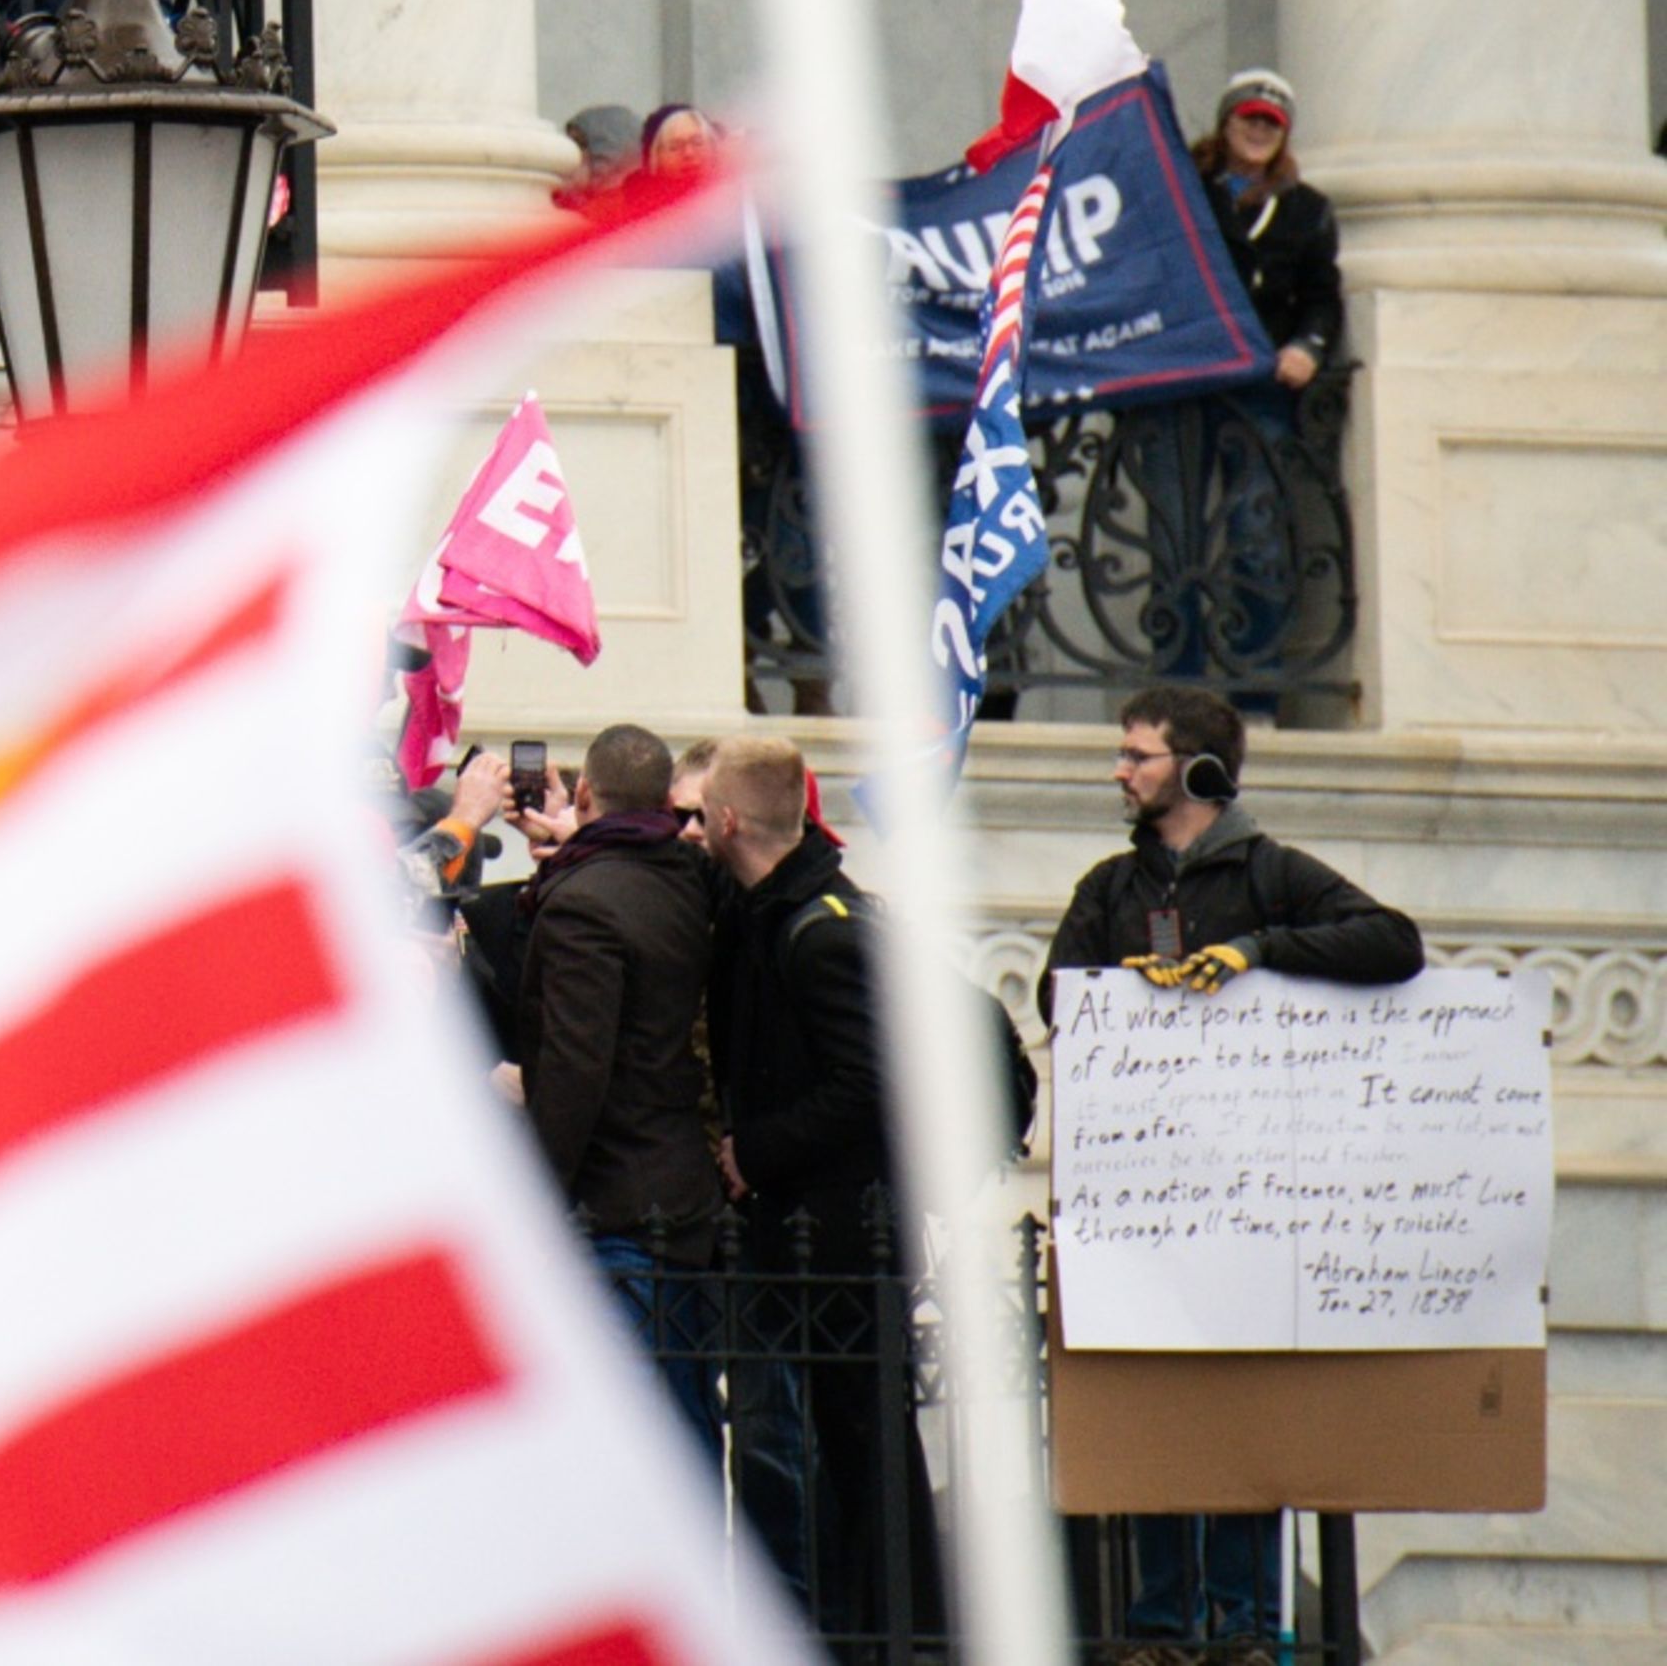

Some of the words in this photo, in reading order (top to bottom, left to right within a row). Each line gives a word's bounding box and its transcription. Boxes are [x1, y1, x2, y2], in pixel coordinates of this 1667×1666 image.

[1069, 988, 1115, 1037] At
[1126, 990, 1193, 1032] what
[1200, 995, 1263, 1046] point
[1275, 998, 1331, 1029] then
[1369, 995, 1410, 1025] the
[1418, 993, 1516, 1039] approach
[1069, 1044, 1107, 1084] of
[1111, 1043, 1202, 1090] danger
[1214, 1041, 1243, 1071] to
[1251, 1043, 1273, 1069] be
[1357, 1071, 1399, 1110] It
[1408, 1071, 1485, 1106] cannot
[1494, 1084, 1544, 1106] come
[1072, 1125, 1127, 1152] from
[1070, 1181, 1102, 1211] As
[1141, 1175, 1214, 1205] nation
[1224, 1169, 1253, 1201] of
[1362, 1179, 1399, 1203] we
[1410, 1168, 1474, 1202] must
[1073, 1214, 1176, 1251] through
[1184, 1208, 1225, 1238] all
[1418, 1247, 1498, 1285] Lincoln
